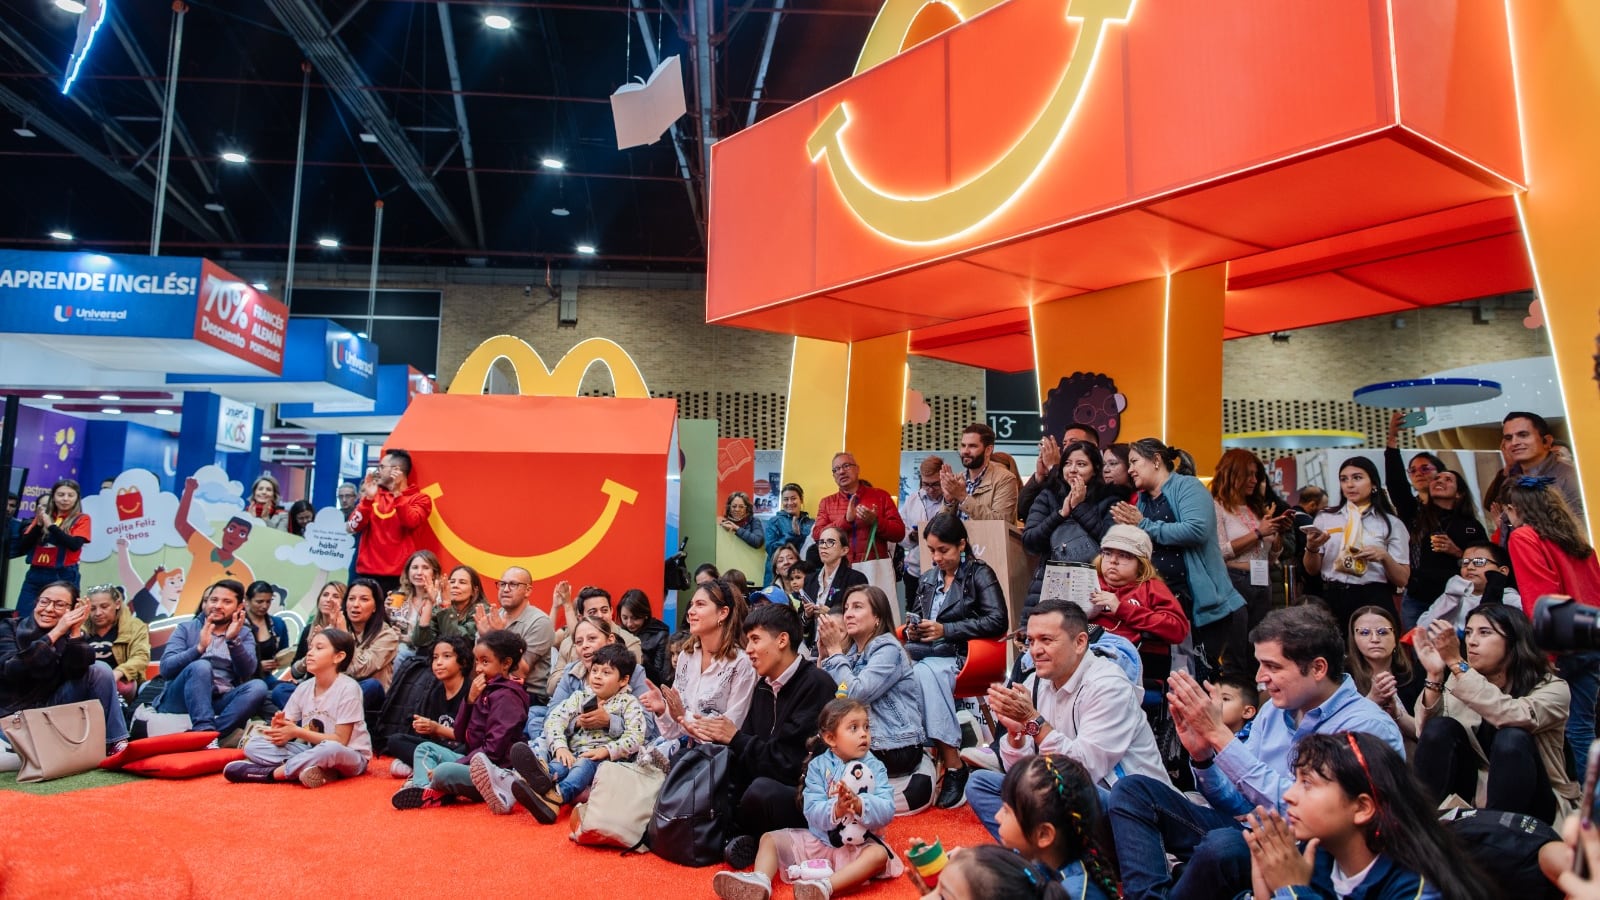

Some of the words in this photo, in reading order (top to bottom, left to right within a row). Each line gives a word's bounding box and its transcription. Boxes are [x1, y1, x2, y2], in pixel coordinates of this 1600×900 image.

[0, 270, 106, 292] APRENDE
[108, 272, 197, 295] INGLÉS!
[76, 308, 127, 319] Universal
[204, 274, 250, 329] 70%
[253, 304, 284, 330] FRANCÉS
[201, 316, 246, 348] Descuento
[251, 322, 283, 348] ALEMÁN
[345, 350, 374, 375] Universal
[106, 523, 134, 535] Cajita
[135, 519, 156, 528] Feliz
[119, 531, 150, 541] ibros
